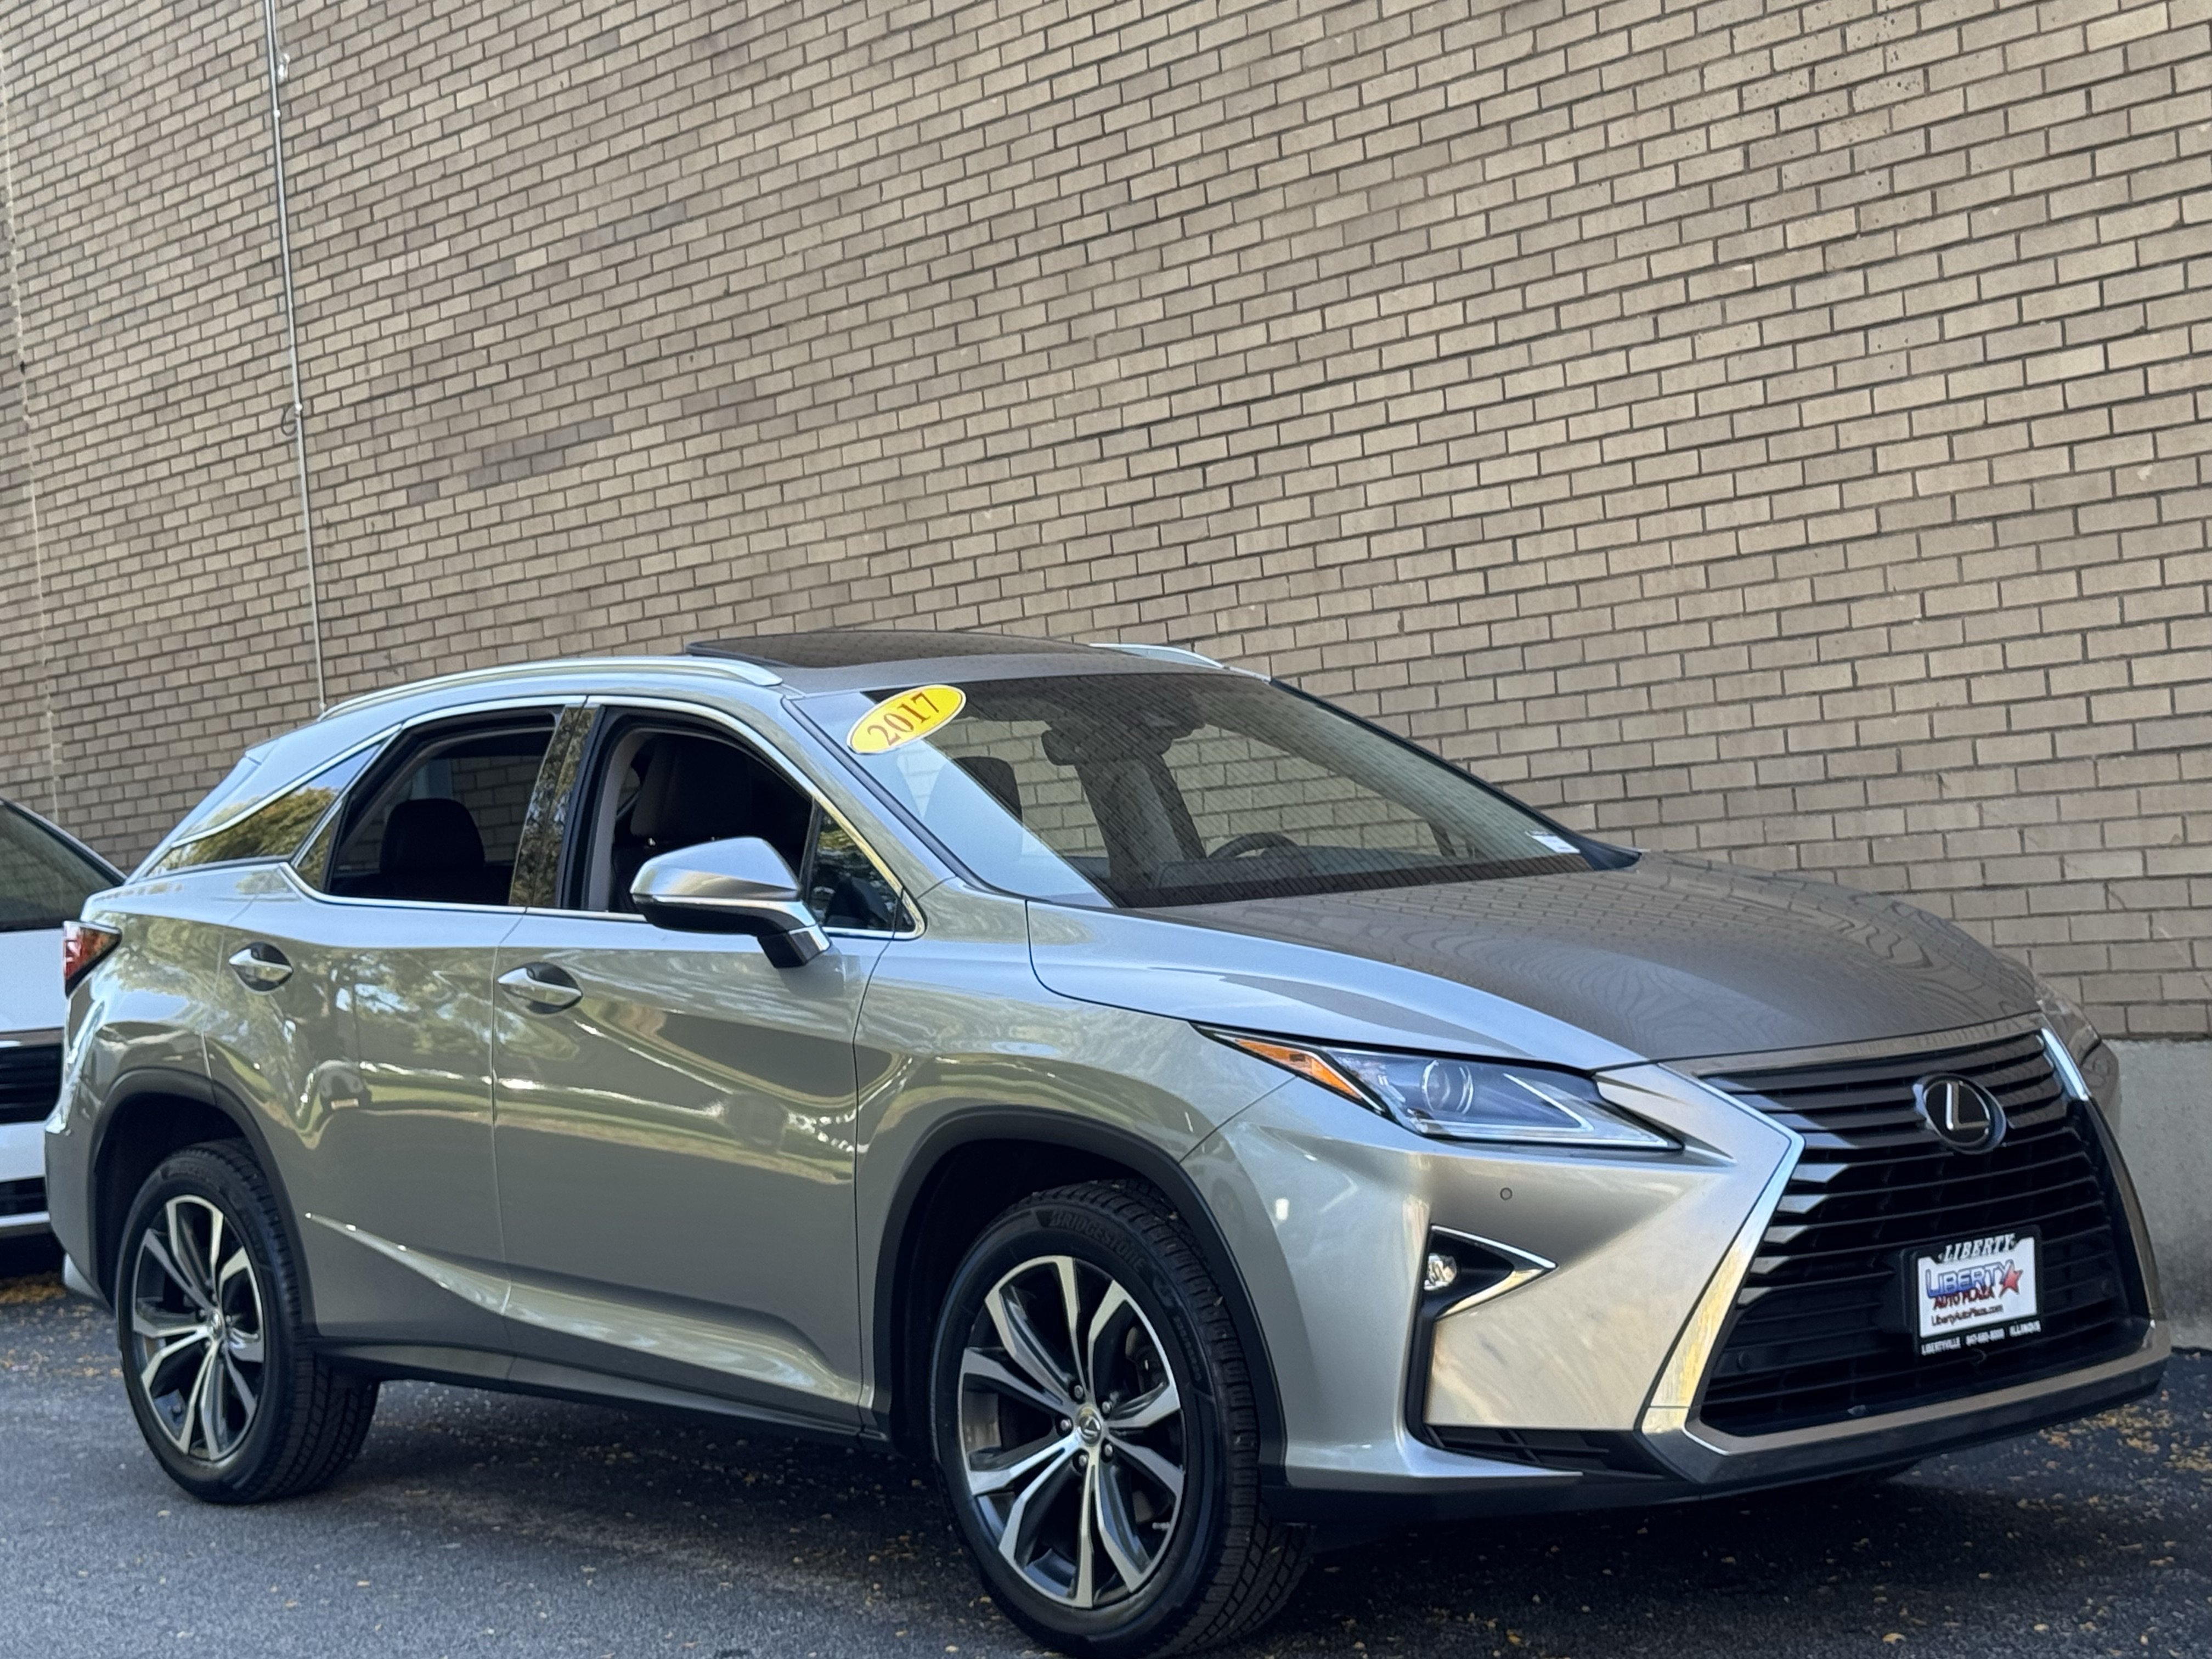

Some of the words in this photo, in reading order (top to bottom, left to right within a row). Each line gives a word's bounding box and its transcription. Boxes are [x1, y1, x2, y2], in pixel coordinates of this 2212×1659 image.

[867, 692, 939, 746] 2017
[1051, 1209, 1147, 1272] BRIDGESTONE
[1942, 1233, 2015, 1261] LIBERTY
[1926, 1259, 2017, 1298] LIBERTY
[1933, 1293, 1960, 1310] AUTO
[1962, 1285, 1995, 1305] PLAZA
